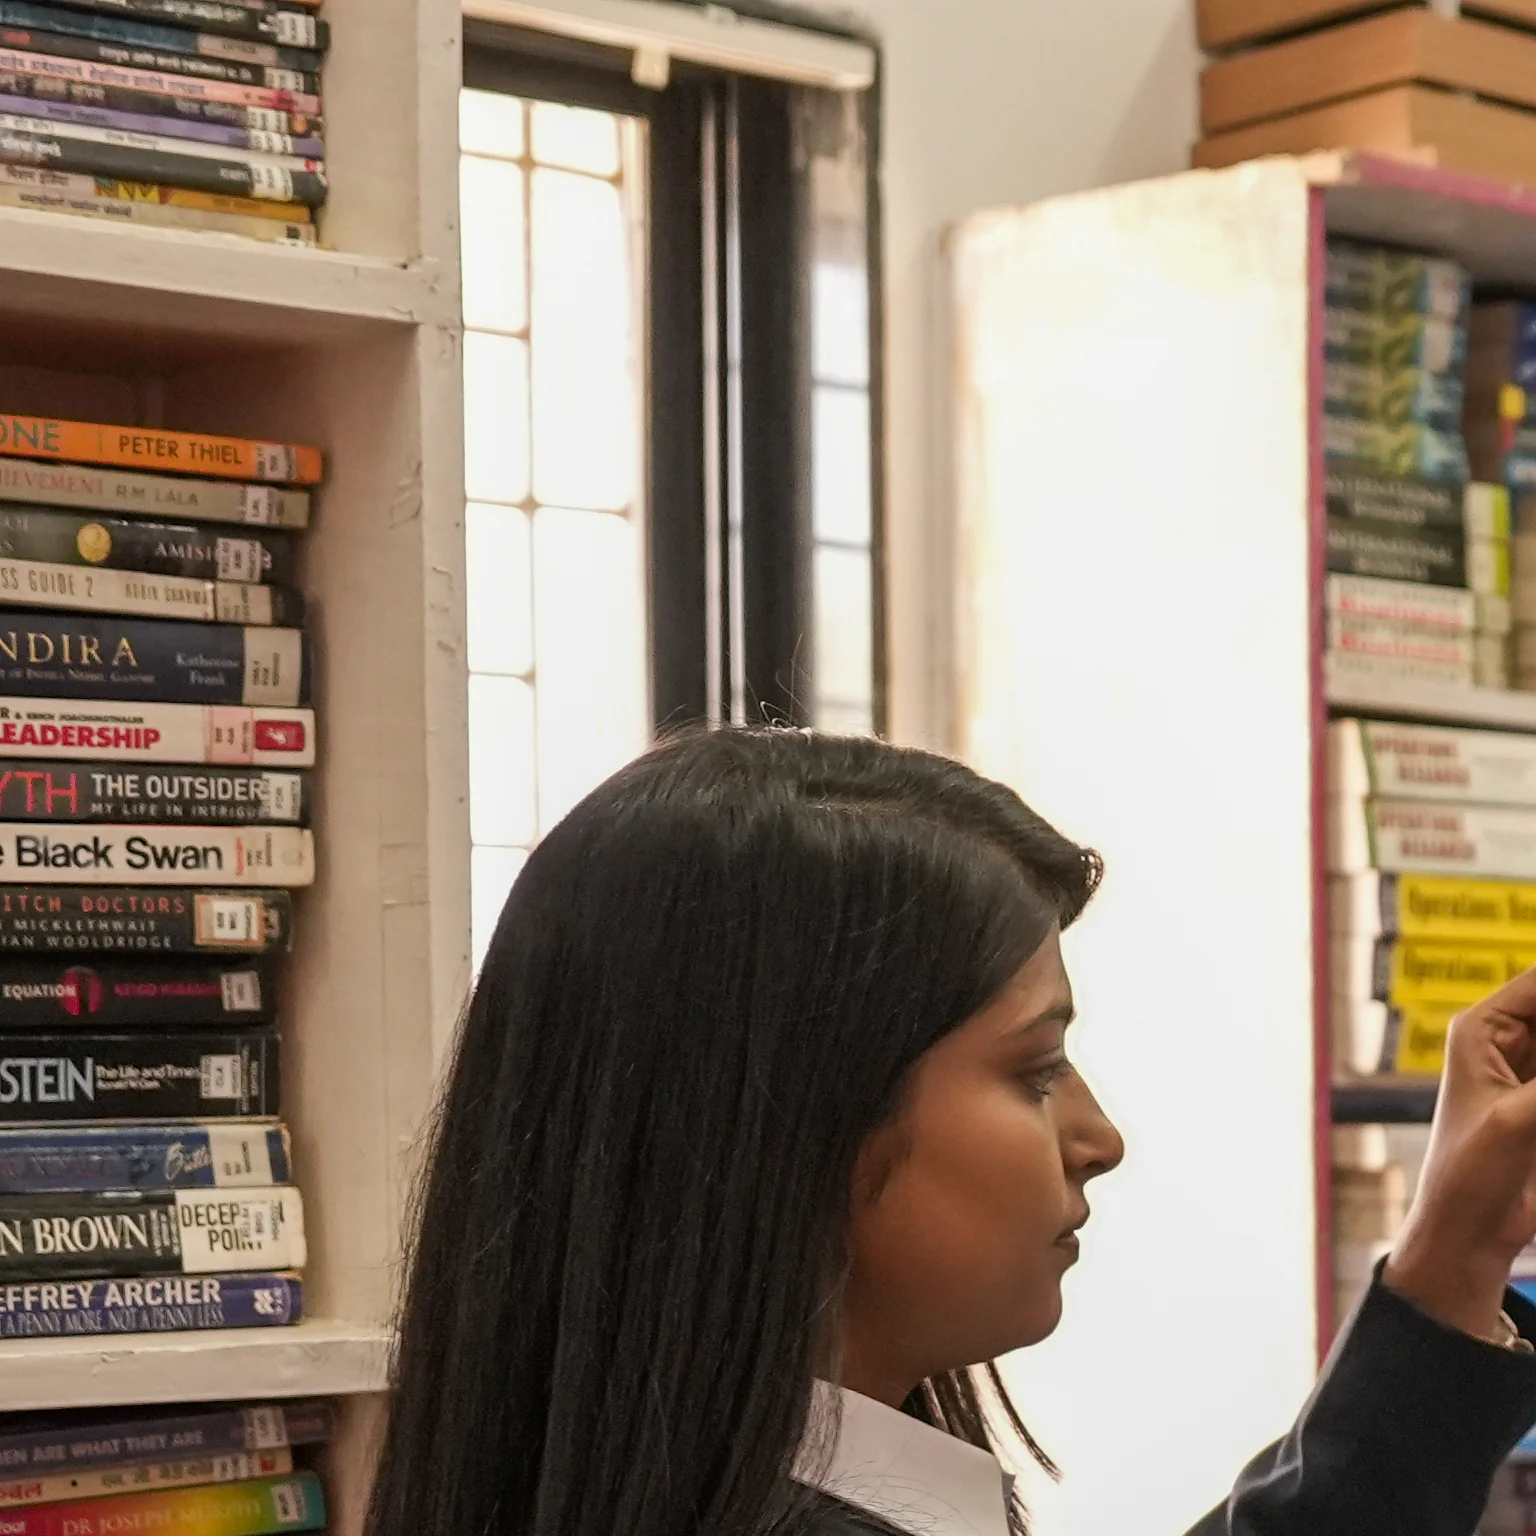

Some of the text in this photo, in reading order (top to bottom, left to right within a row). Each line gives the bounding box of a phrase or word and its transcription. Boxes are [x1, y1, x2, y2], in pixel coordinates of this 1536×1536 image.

[119, 435, 180, 458] PETER
[190, 442, 243, 465] THIEL
[28, 569, 74, 595] GUIDE
[86, 579, 94, 598] 2
[91, 774, 139, 797] THE
[146, 774, 262, 799] OUTSIDER
[90, 802, 182, 816] MY LIFE IN
[15, 835, 223, 870] Black Swan
[81, 896, 186, 913] DOCTORS
[49, 935, 172, 948] WOOLDRIDGE
[3, 984, 78, 999] EQUATION
[0, 1057, 94, 1102] STEIN
[33, 1215, 149, 1255] BROWN
[104, 1279, 222, 1308] ARCHER
[63, 1509, 171, 1536] DR JOSEPH
